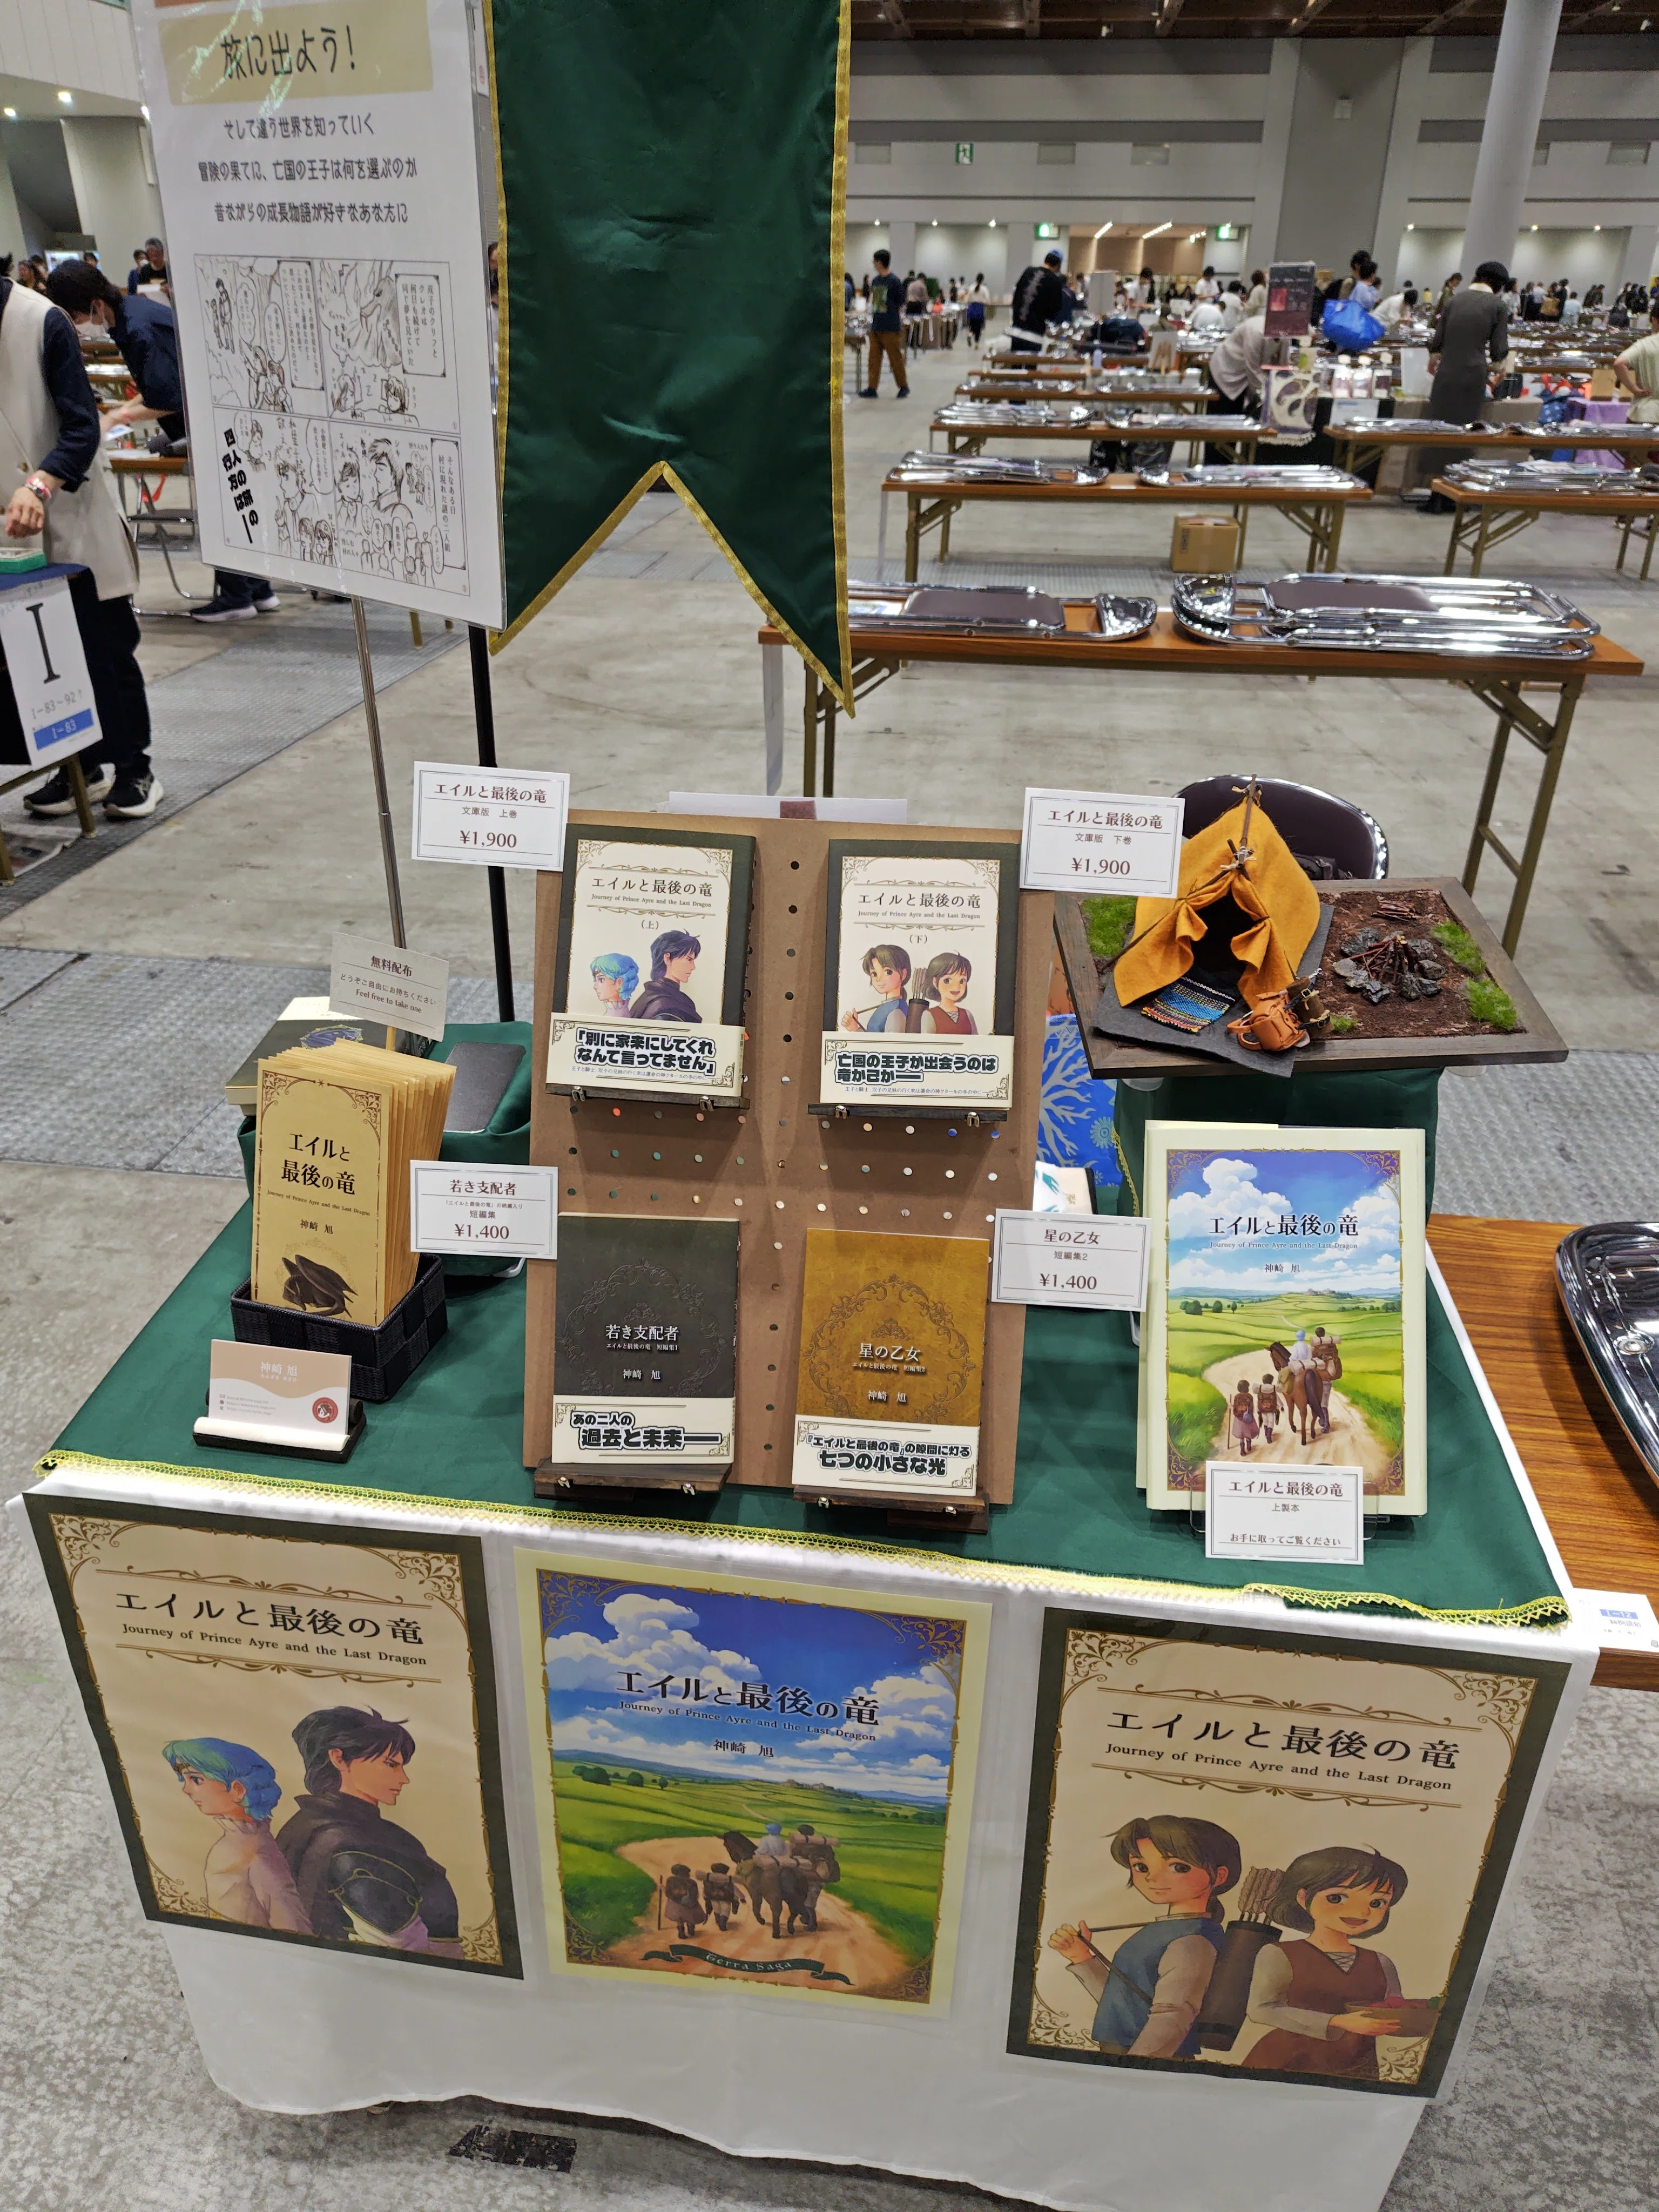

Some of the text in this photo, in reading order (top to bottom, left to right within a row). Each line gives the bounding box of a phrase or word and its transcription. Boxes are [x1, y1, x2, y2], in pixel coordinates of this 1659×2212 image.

[224, 113, 374, 140] そして違う世界を知っていく
[224, 428, 259, 526] 四人の旅の
[434, 783, 547, 804] エイルと最後の竜
[462, 805, 517, 819] 文庫版 上巻
[1047, 808, 1163, 830] エイルと最後の竜
[459, 830, 517, 848] ¥1,900
[1075, 832, 1132, 846] 文庫版 下巻
[1071, 857, 1131, 875] ¥1,900
[592, 877, 712, 897] エイルと最後の竜
[858, 893, 980, 908] エイルと最後の竜
[370, 955, 413, 977] 無料配布
[356, 989, 369, 999] Feel
[372, 993, 385, 1002] free
[395, 1000, 408, 1009] take
[410, 1005, 422, 1013] one
[576, 1049, 716, 1075] なんて言ってません」
[837, 1053, 997, 1072] 亡国の王子が出会うのは
[288, 1133, 350, 1162] エイルと
[281, 1159, 355, 1195] 最後の竜
[449, 1179, 516, 1196] 若き支配者
[267, 1190, 284, 1199] Journey
[354, 1208, 370, 1216] Dragon
[469, 1210, 496, 1219] 短編集
[324, 1224, 333, 1234] 旭
[454, 1223, 509, 1240] ¥1,400
[1209, 1215, 1359, 1236] エイルと最後の竜
[1043, 1229, 1100, 1245] 星の乙女
[1054, 1251, 1088, 1261] 短編集2
[1291, 1264, 1300, 1273] 旭
[1039, 1272, 1097, 1290] ¥1,400
[605, 1324, 679, 1341] 若き支配者
[606, 1343, 651, 1351] エイルと最後の竜
[858, 1342, 921, 1362] 星の乙女
[287, 1364, 298, 1377] 旭
[651, 1370, 662, 1380] 旭
[896, 1391, 907, 1403] 旭
[572, 1412, 633, 1426] あの二人の
[807, 1434, 970, 1457] 『エイルと最後の竜』の隙間に灯る
[819, 1450, 947, 1476] 七つの小さな光
[1228, 1480, 1344, 1498] エイルと最後の竜
[1272, 1502, 1300, 1513] 上製本
[1230, 1532, 1341, 1548] お手に取ってご覧ください
[116, 1593, 423, 1644] エイルと最後の竜
[122, 1623, 427, 1665] Journey of Prince Ayre and the Last Dragon
[616, 1671, 880, 1725] エイルと最後の竜
[619, 1701, 663, 1714] Journey
[685, 1710, 720, 1720] Prince
[726, 1715, 752, 1724] Ayre
[784, 1722, 801, 1731] the
[807, 1725, 830, 1735] Last
[836, 1729, 876, 1741] Dragon
[1107, 1712, 1460, 1769] エイルと最後の竜
[758, 1745, 774, 1757] 旭
[1105, 1743, 1452, 1790] Journey of Prince Ayre and the Last Dragon
[706, 1953, 792, 1971] Terra Saga
